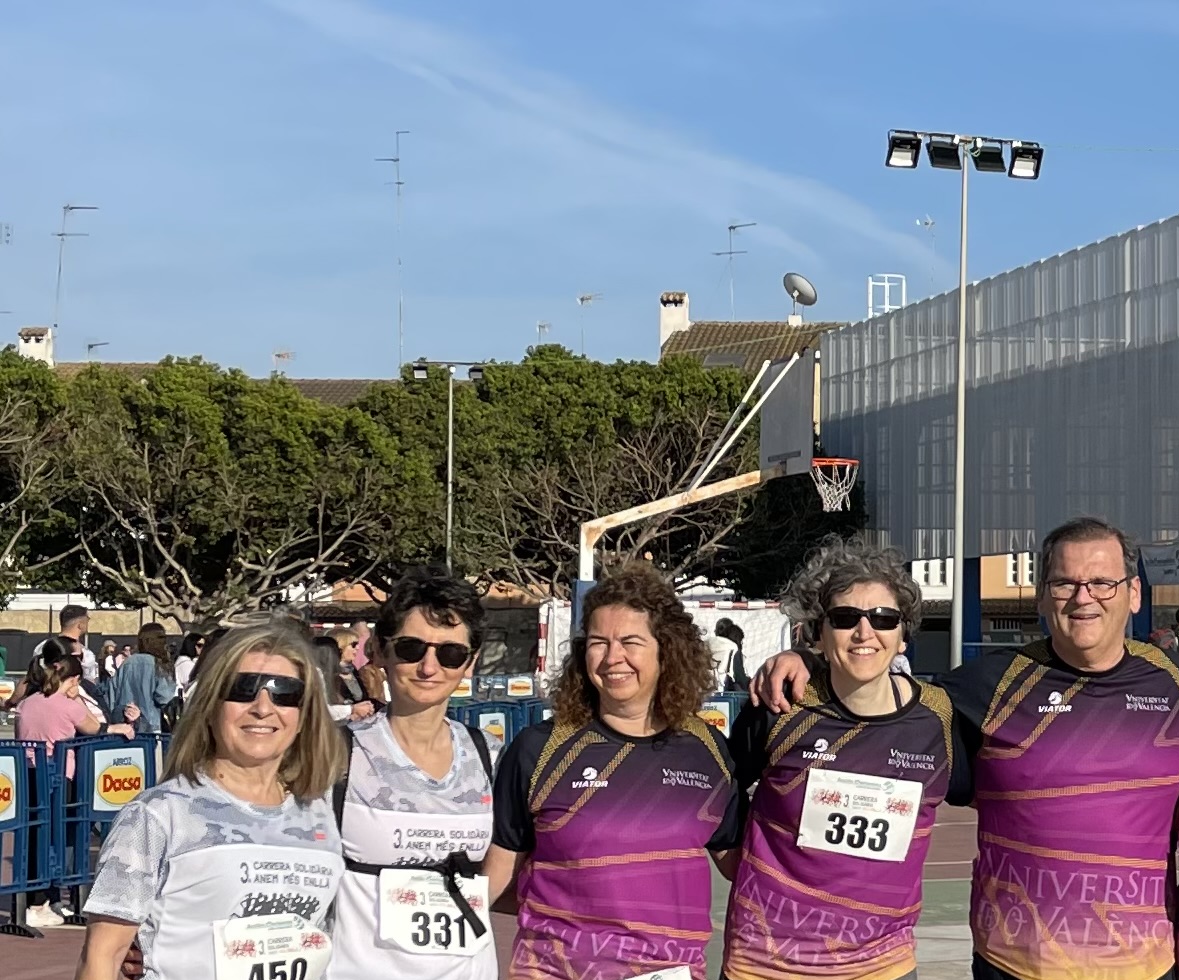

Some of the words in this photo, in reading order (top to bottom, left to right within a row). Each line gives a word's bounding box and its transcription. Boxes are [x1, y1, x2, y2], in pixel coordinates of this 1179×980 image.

[1038, 705, 1072, 713] VIATOR
[802, 751, 837, 761] VIATOR
[103, 774, 141, 793] Dacsa
[572, 780, 609, 788] VIATOR
[406, 828, 445, 839] CARRERA
[824, 812, 890, 852] 333
[405, 841, 431, 850] ANEM
[435, 840, 455, 851] MÉS
[253, 861, 290, 871] CARRERA
[253, 874, 279, 884] ANEM
[283, 874, 300, 885] MÉS
[411, 911, 466, 948] 331
